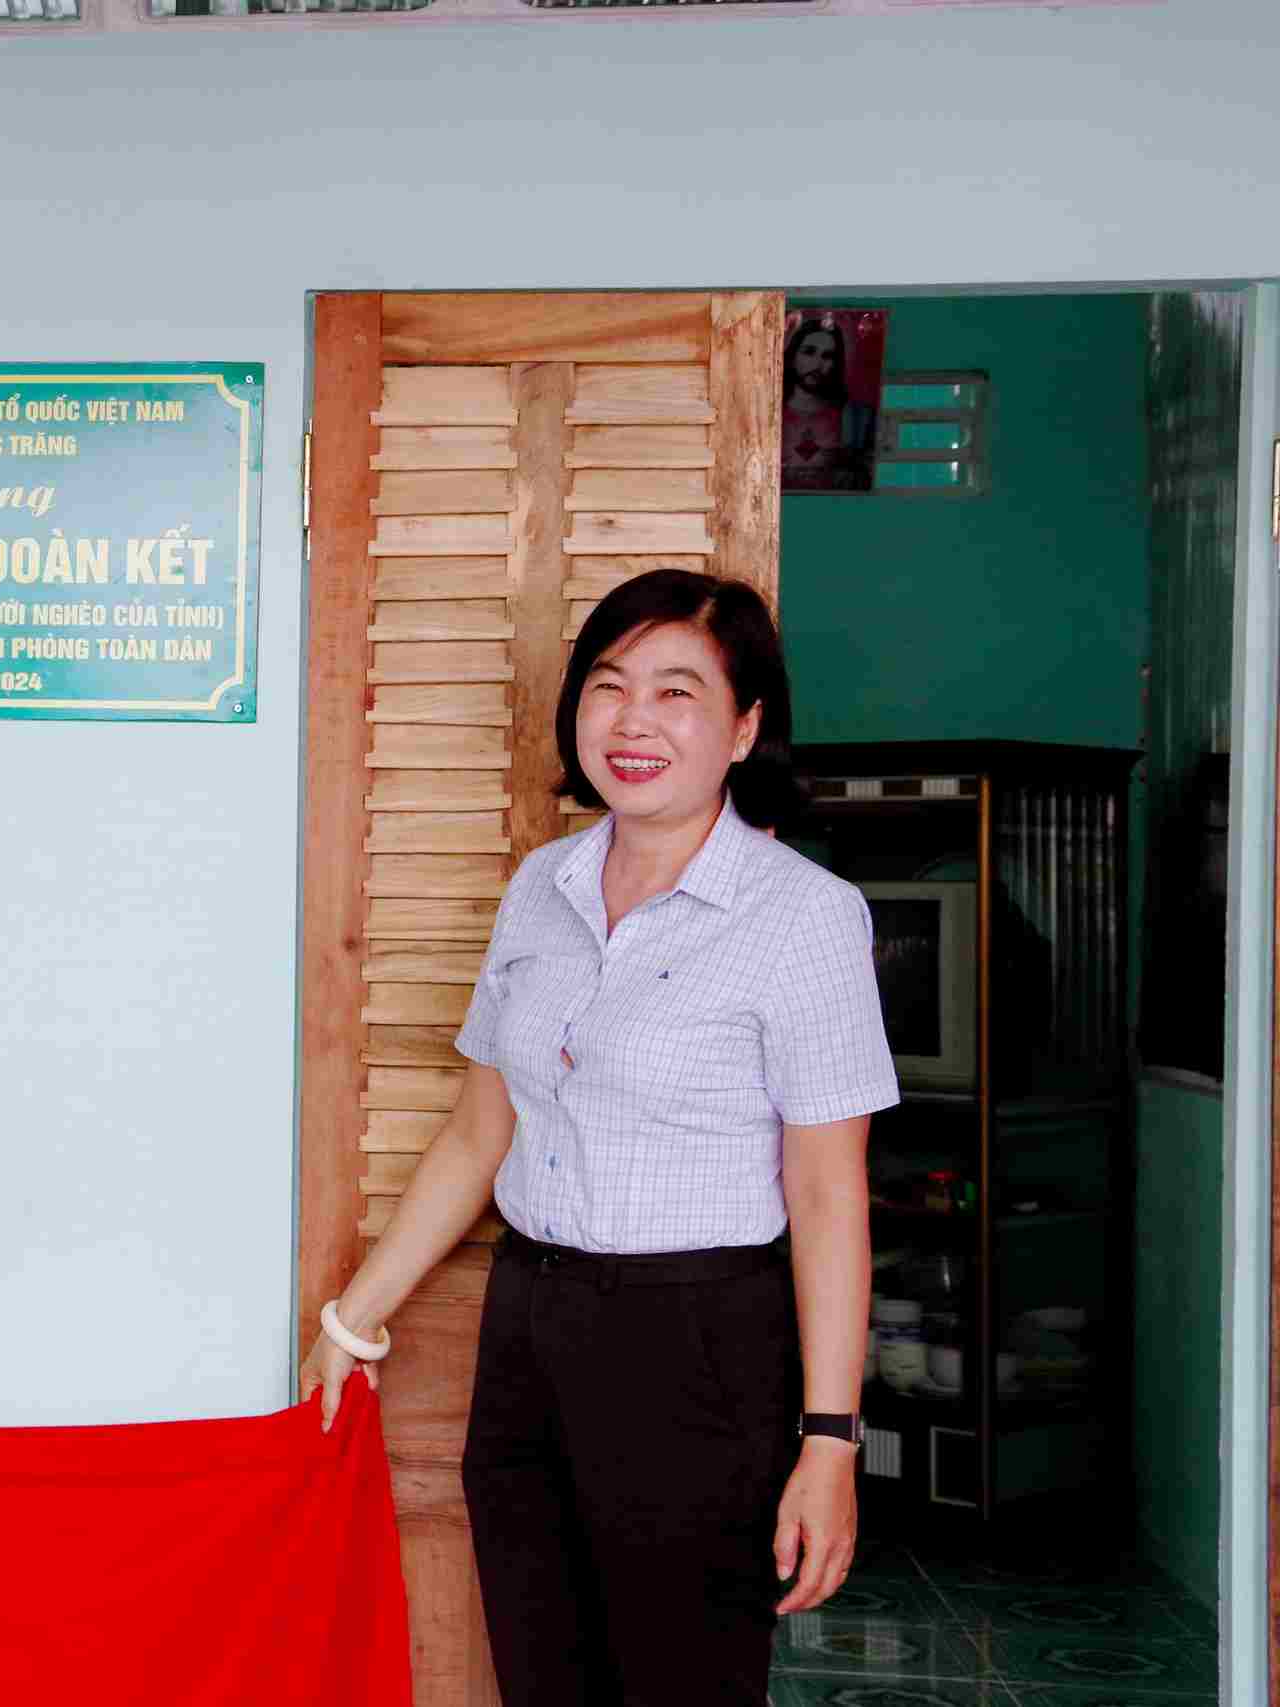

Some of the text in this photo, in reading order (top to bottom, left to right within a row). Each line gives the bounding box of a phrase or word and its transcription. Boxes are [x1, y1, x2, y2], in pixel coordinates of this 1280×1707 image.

[25, 393, 80, 423] QUỐC
[86, 397, 130, 425] VIỆT
[135, 400, 184, 421] NAM
[10, 432, 77, 456] TRĂNG
[126, 523, 214, 585] KẾT
[33, 599, 106, 625] NGHÈO
[113, 598, 158, 627] CỦA
[166, 598, 224, 629] TỈNH)
[12, 632, 89, 659] PHÒNG
[96, 634, 157, 660] TOÀN
[164, 635, 212, 661] DÂN
